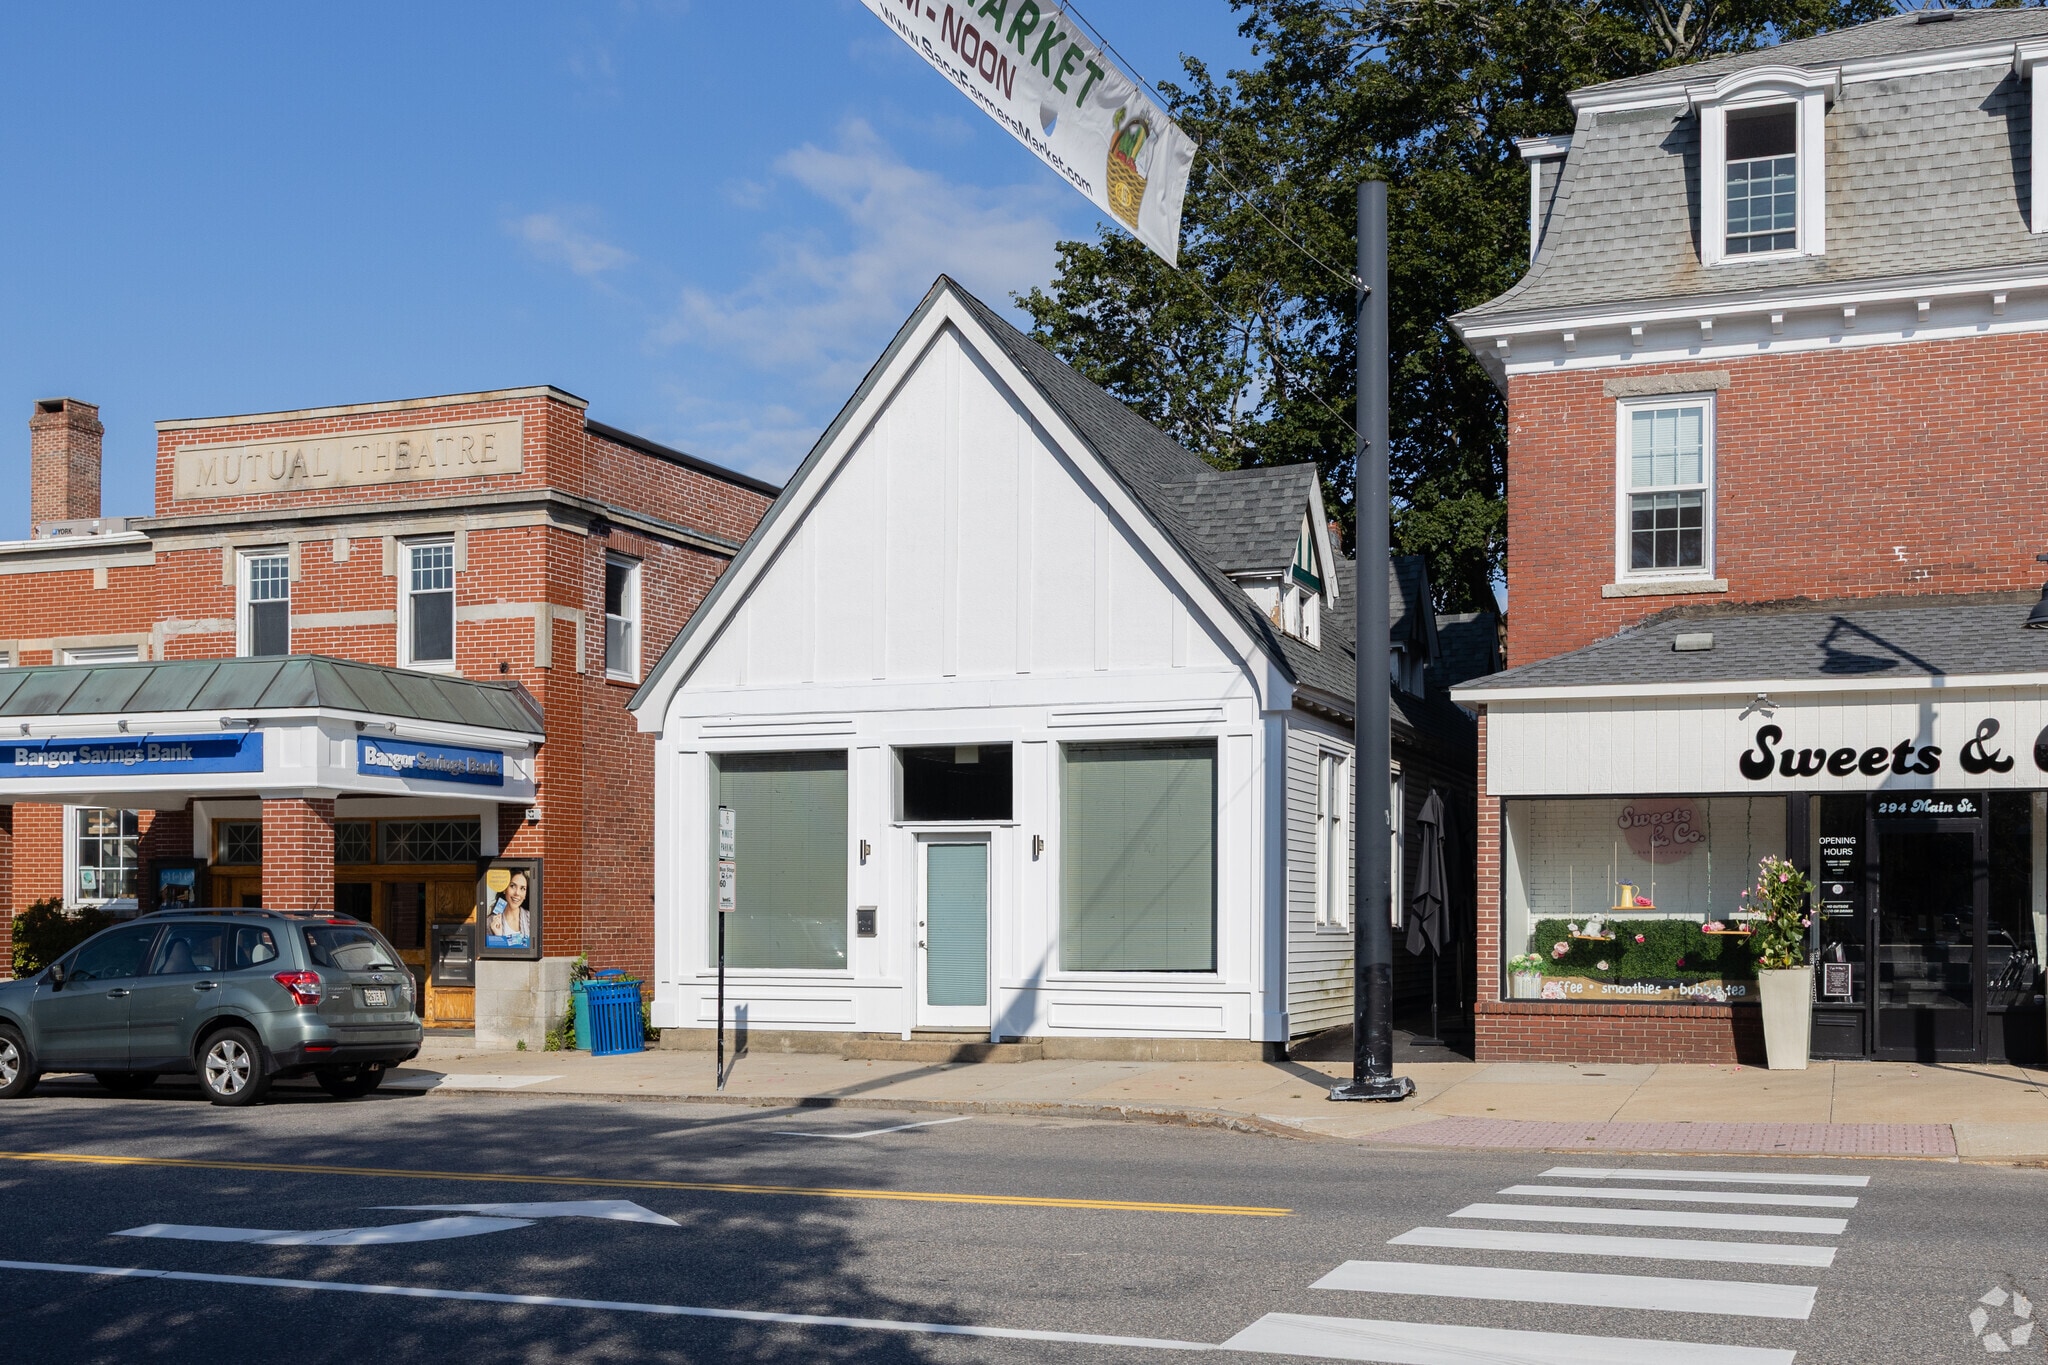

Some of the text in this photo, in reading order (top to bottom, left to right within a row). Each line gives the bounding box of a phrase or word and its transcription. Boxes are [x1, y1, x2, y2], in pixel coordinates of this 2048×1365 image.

[941, 3, 1017, 102] NOON
[966, 0, 1105, 109] ARKET
[880, 2, 1093, 197] www.SacoFarmersMarket.com
[195, 431, 499, 488] MUTUAL THEATRE
[14, 742, 194, 769] Bangor Savings Bank
[364, 745, 500, 776] Bangor Savings Bank
[1739, 724, 1942, 780] Sweets
[1959, 717, 2014, 775] &
[1618, 806, 1691, 829] Sweets
[1878, 797, 1977, 814] 294 Main St.
[720, 842, 734, 853] PARKING
[1649, 821, 1706, 848] & Co.
[1819, 837, 1856, 845] OPENING
[1823, 847, 1854, 856] HOURS
[1601, 981, 1661, 995] smoothies
[1679, 982, 1722, 995] bubble
[1725, 984, 1746, 996] tea
